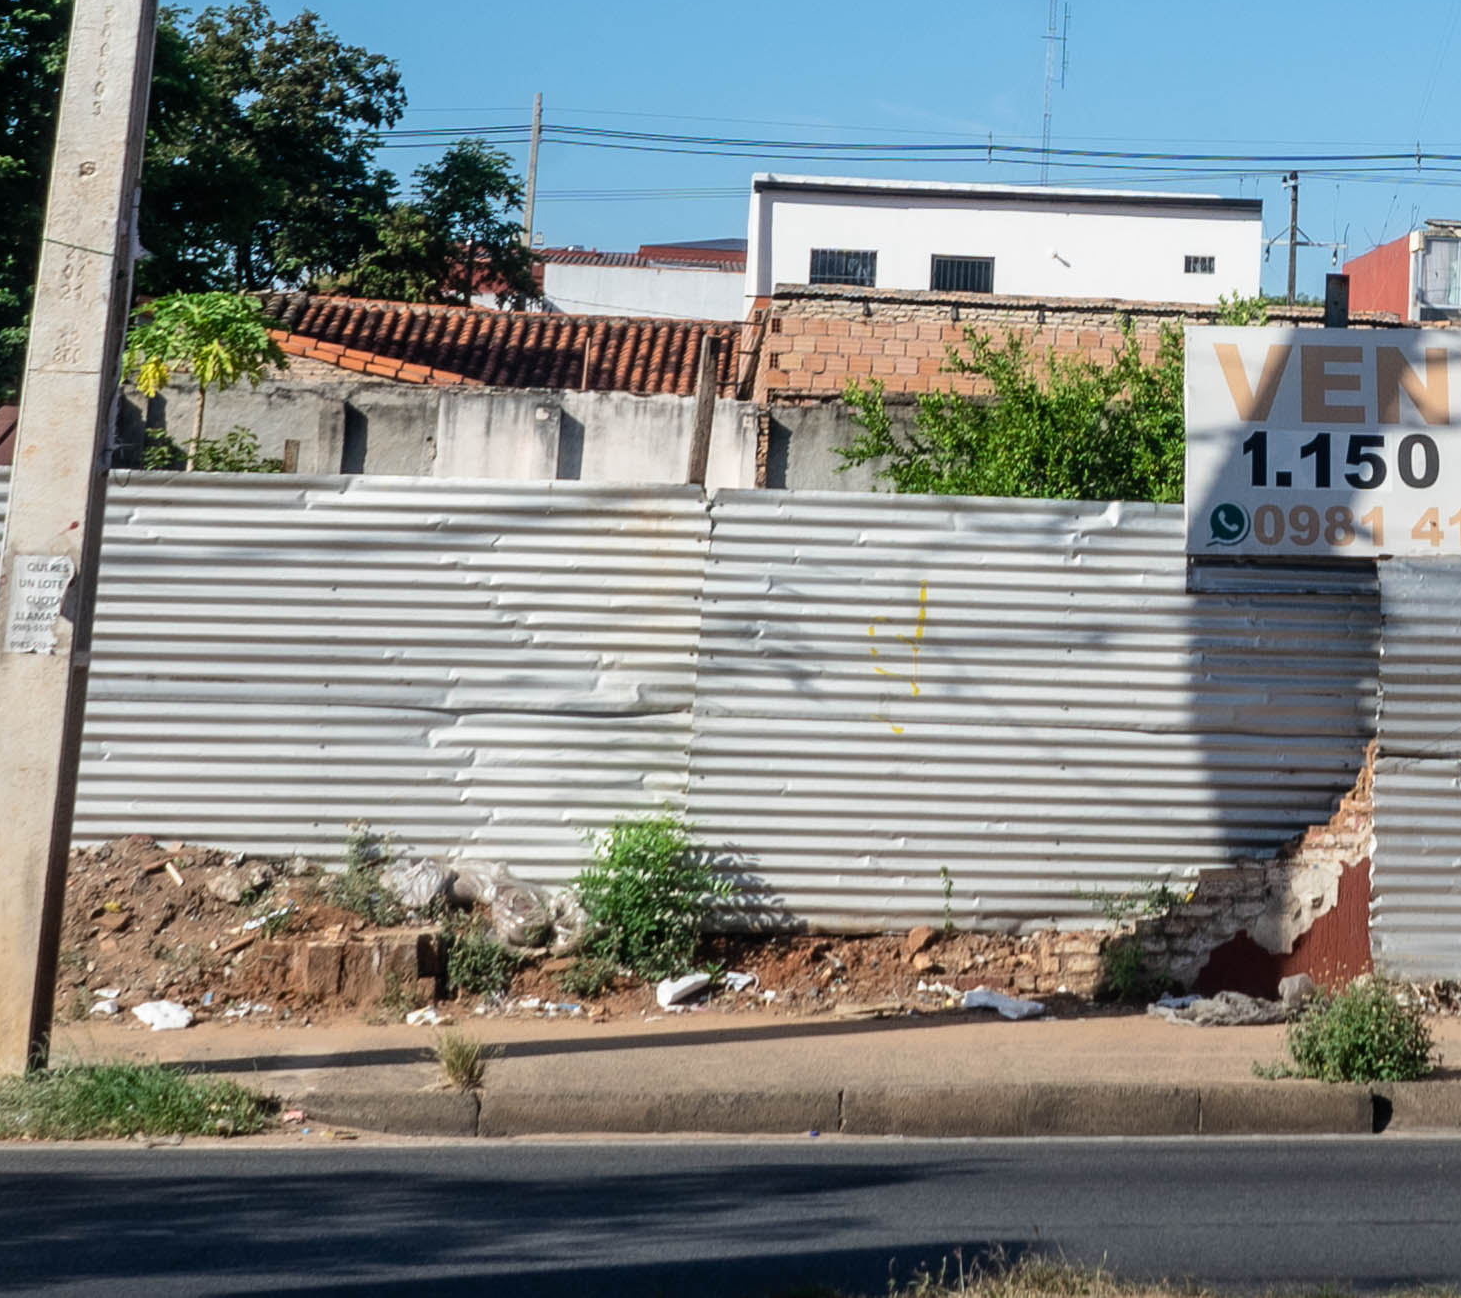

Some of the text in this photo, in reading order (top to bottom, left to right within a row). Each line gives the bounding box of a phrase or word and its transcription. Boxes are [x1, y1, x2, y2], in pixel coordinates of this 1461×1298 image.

[1242, 431, 1440, 490] 1.150
[1254, 504, 1384, 547] 0981
[19, 579, 64, 589] UN LOTE
